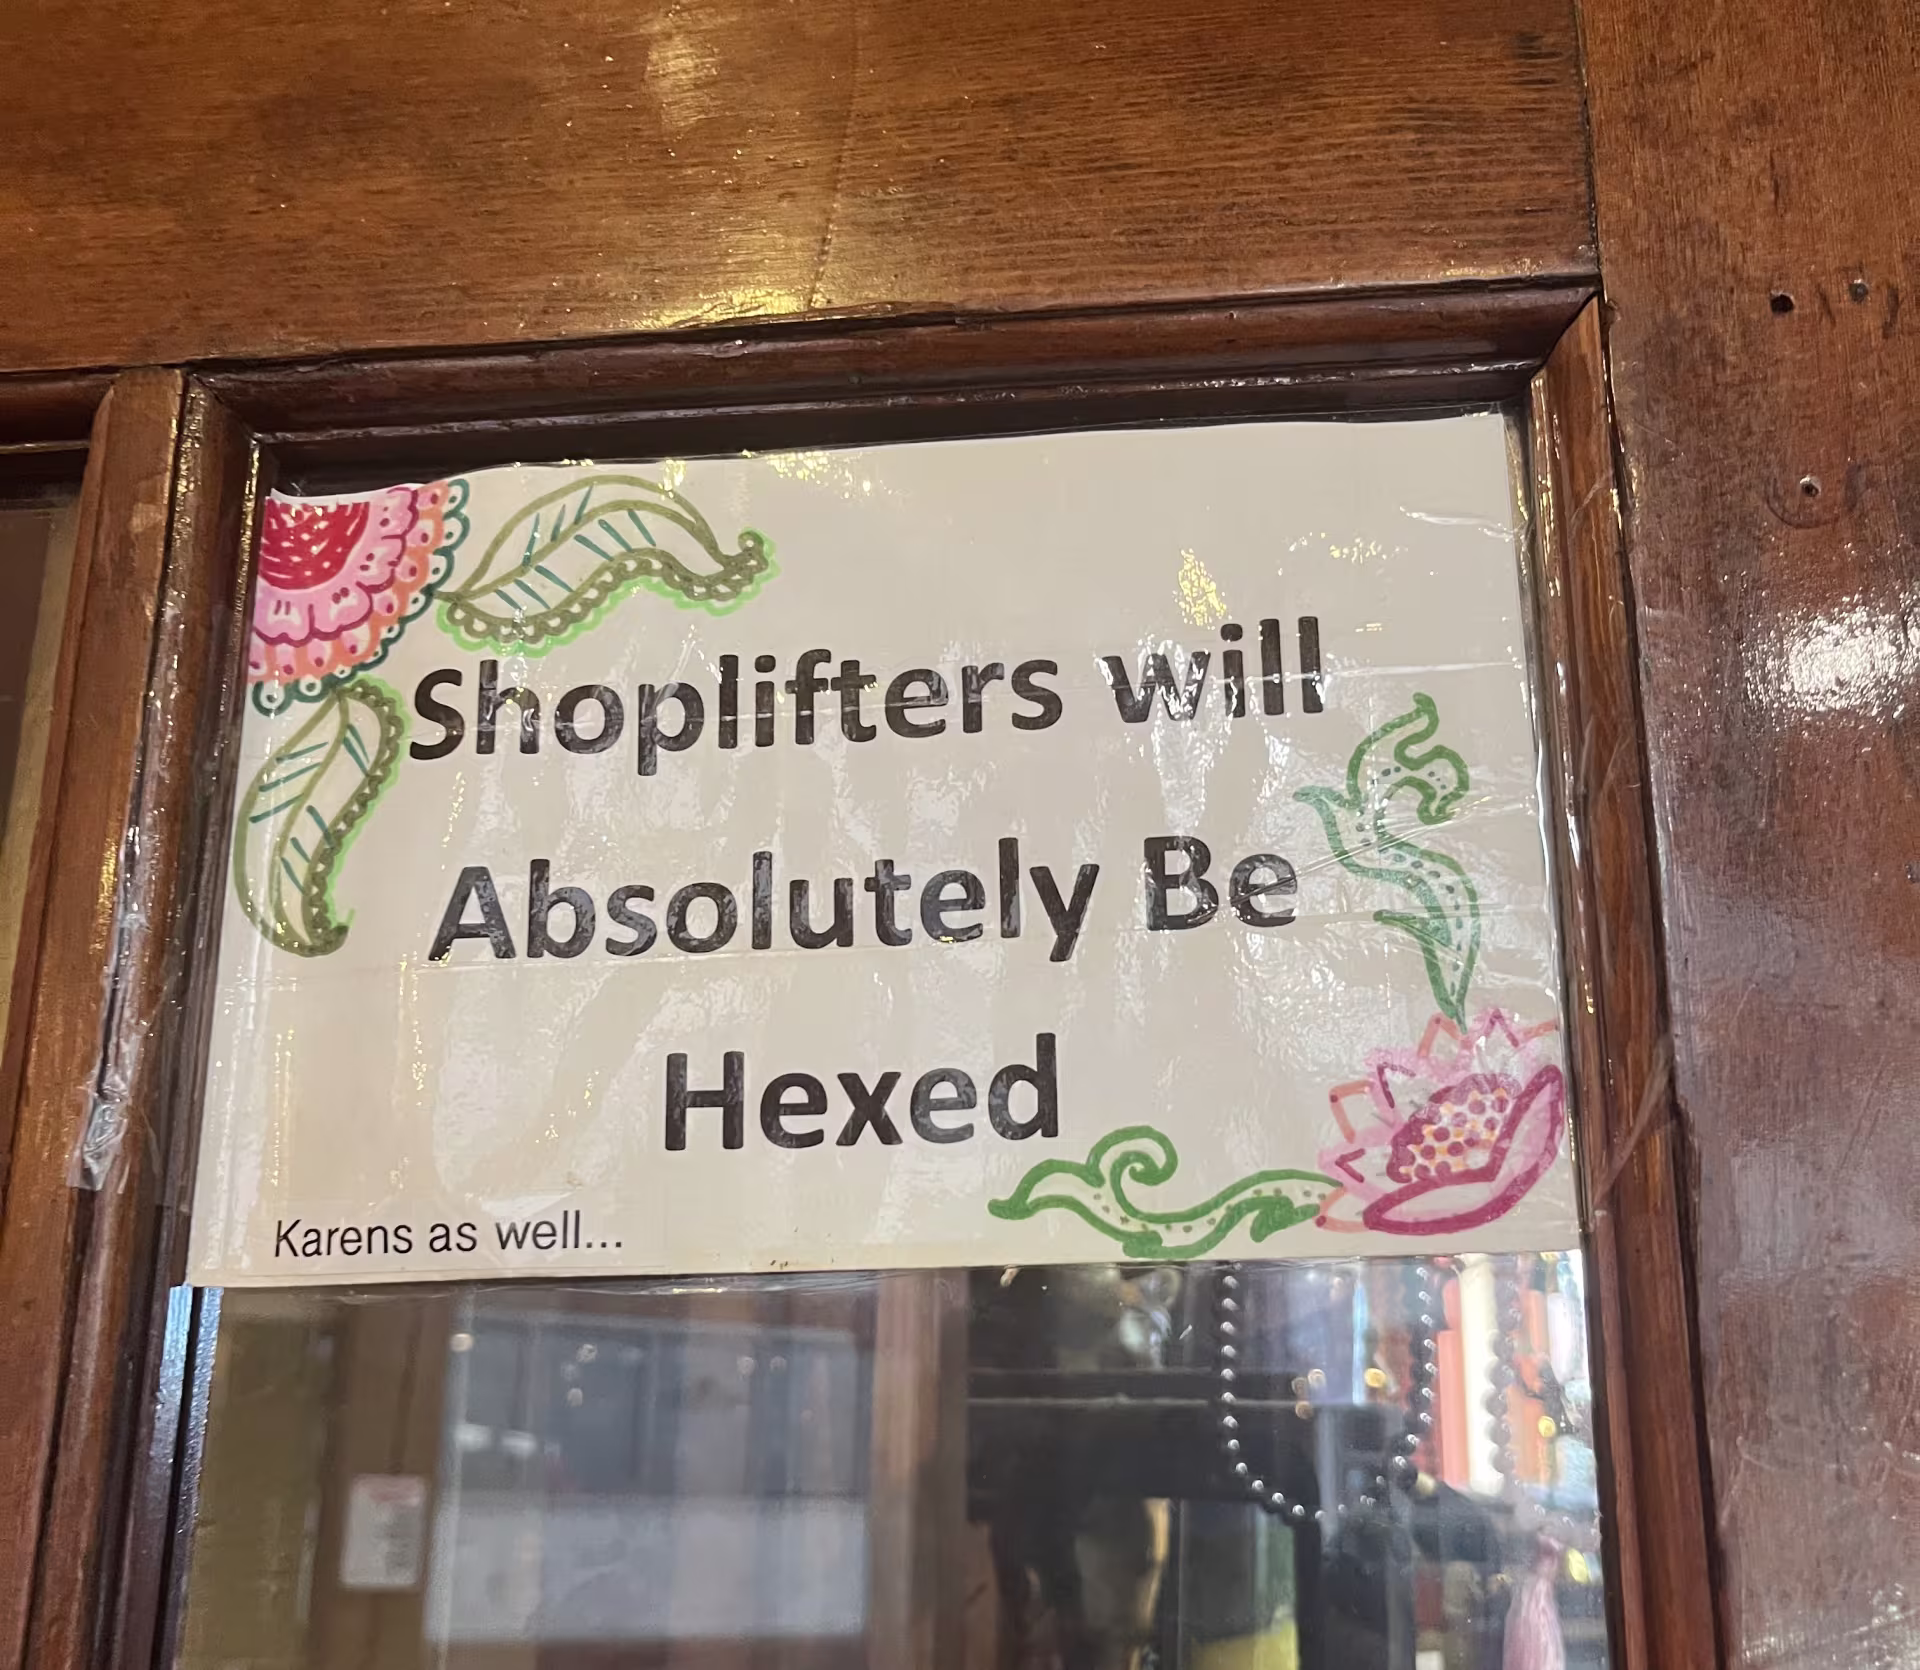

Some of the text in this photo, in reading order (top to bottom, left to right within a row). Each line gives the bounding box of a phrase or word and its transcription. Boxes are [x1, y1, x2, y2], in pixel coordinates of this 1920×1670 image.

[410, 615, 1325, 777] Shoplifters will
[428, 835, 1298, 963] Absolutely Be
[663, 1032, 1060, 1152] Hexed
[274, 1209, 624, 1258] Karens as well...
